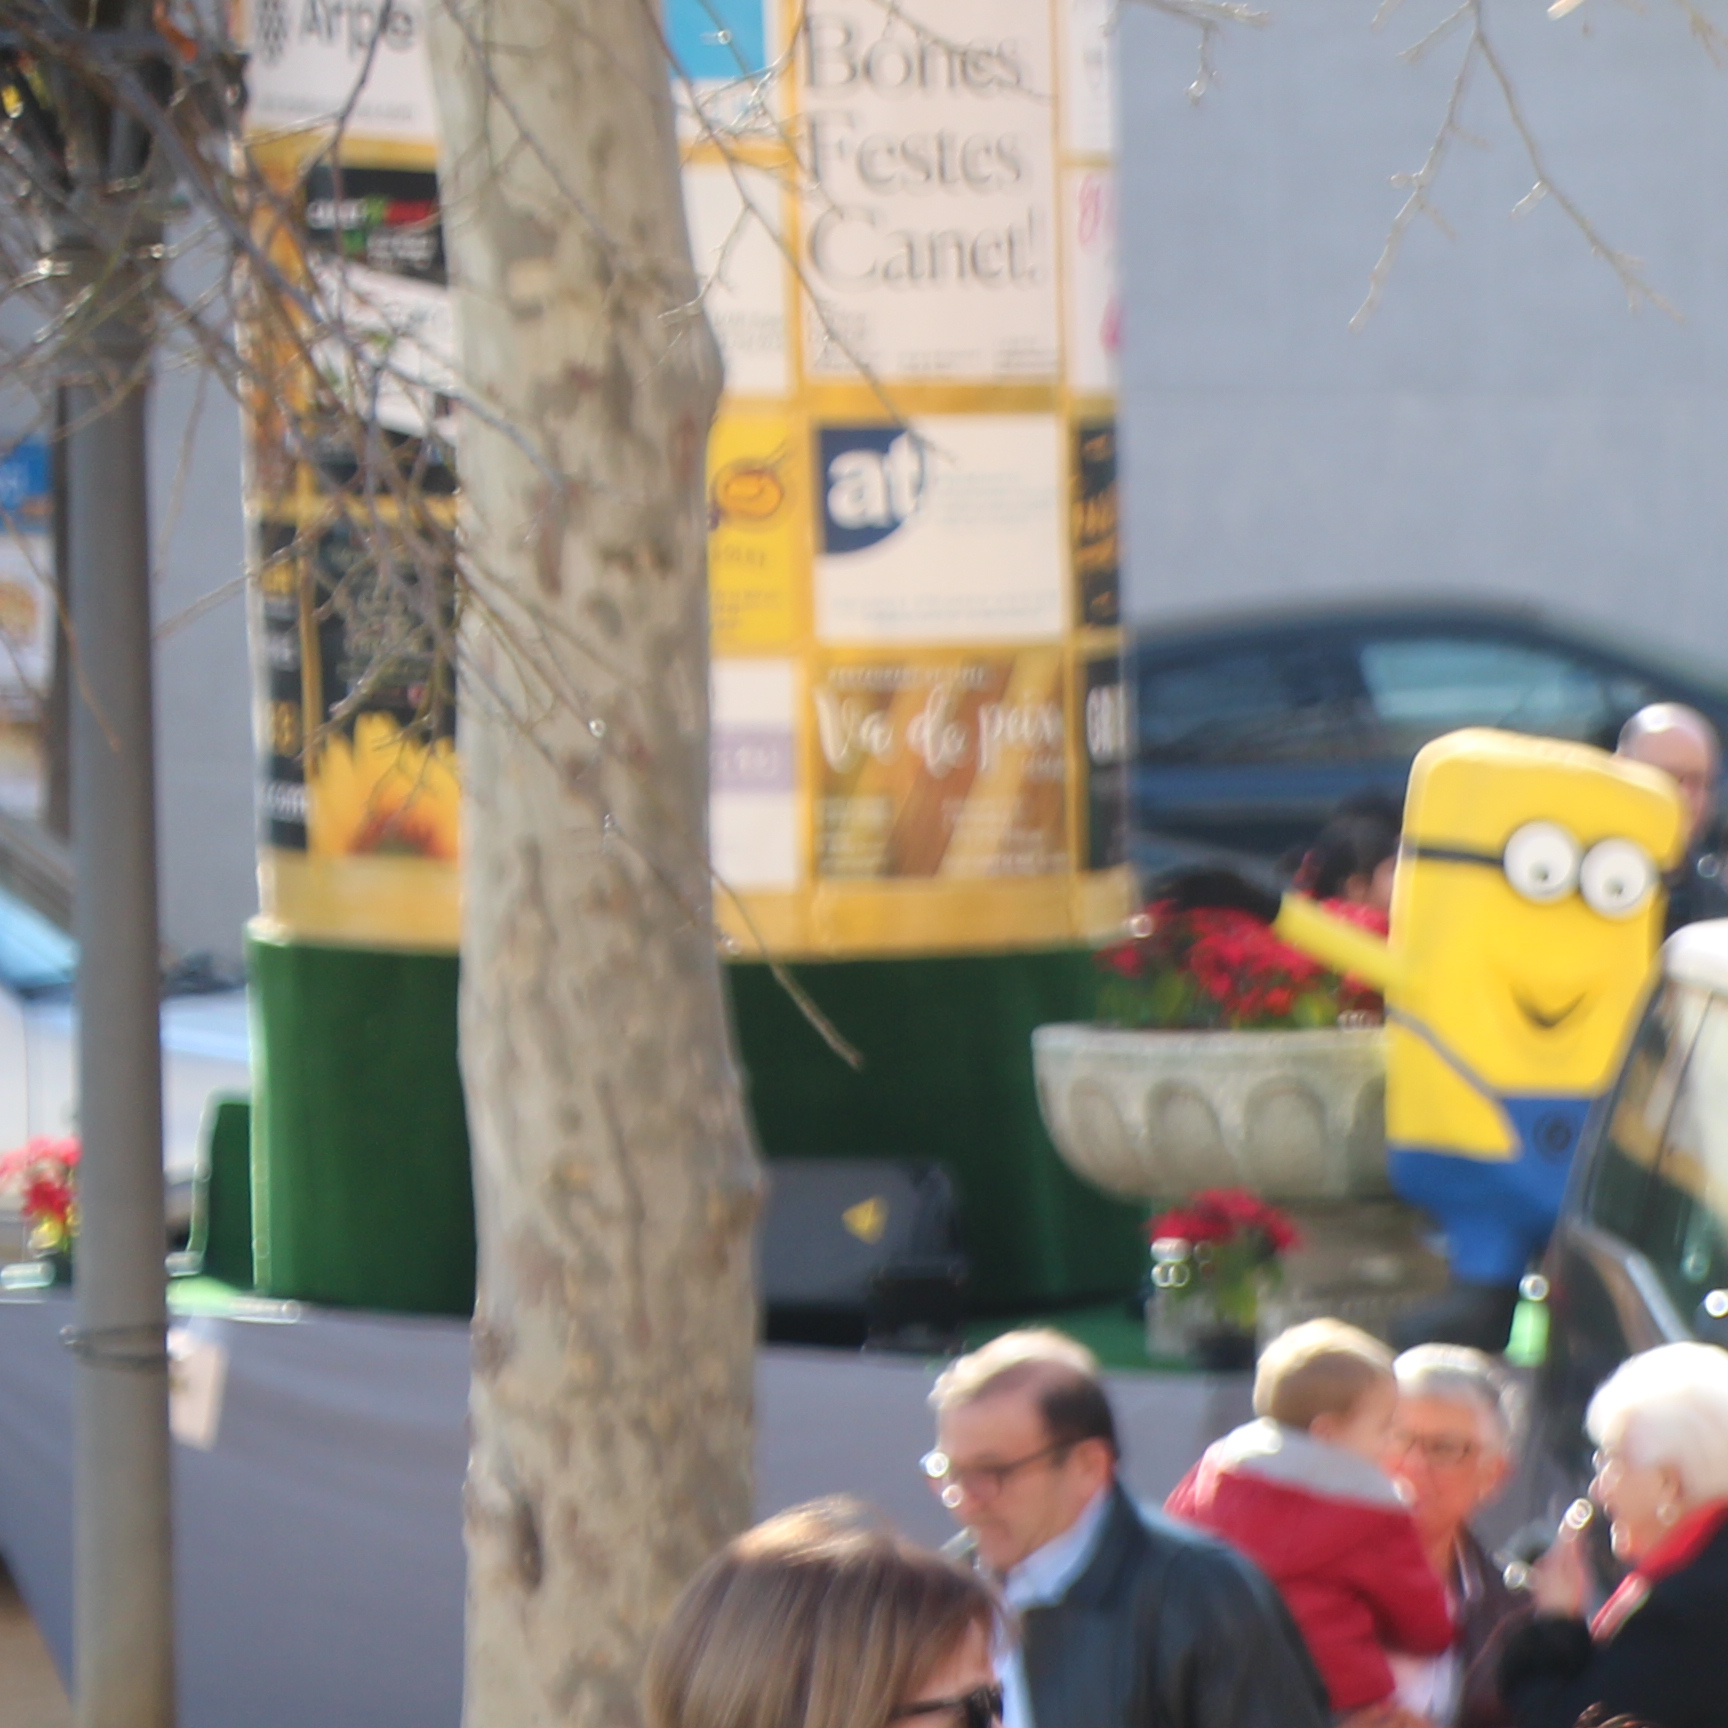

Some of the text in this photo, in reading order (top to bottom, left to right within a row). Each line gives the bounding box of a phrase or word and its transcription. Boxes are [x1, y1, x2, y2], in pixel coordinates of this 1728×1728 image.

[806, 13, 1025, 90] Bones
[808, 112, 1025, 188] Festes
[808, 204, 1041, 289] Canet!
